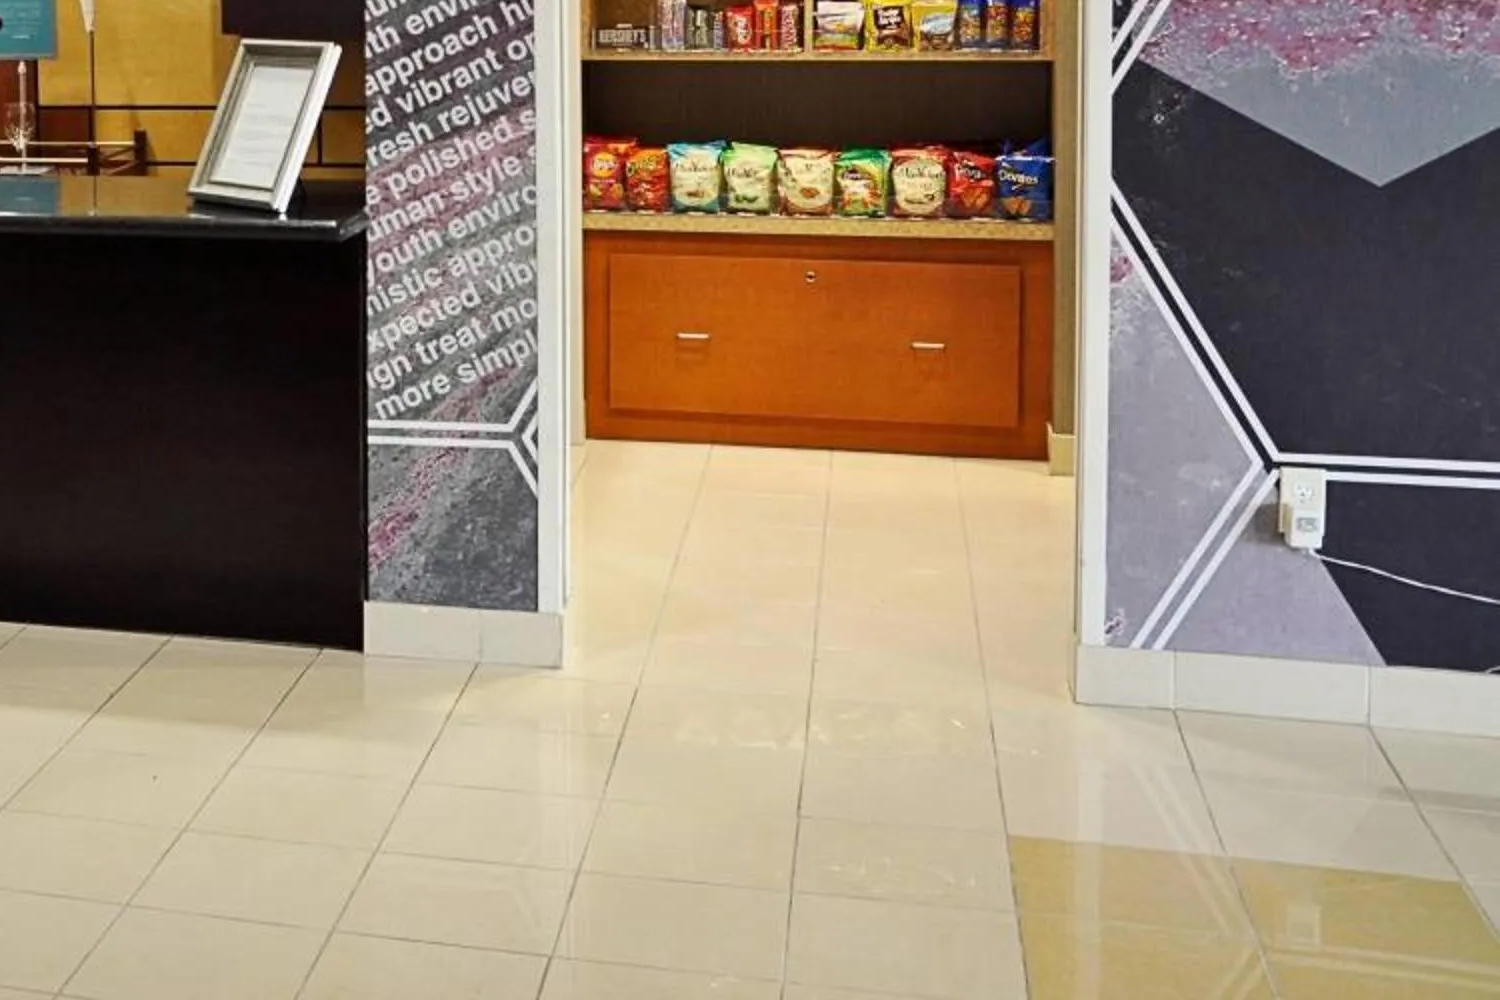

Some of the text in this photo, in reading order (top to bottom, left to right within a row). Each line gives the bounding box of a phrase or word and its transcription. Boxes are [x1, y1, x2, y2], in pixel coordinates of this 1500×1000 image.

[365, 13, 498, 97] approach
[397, 47, 502, 115] vibrant
[387, 114, 514, 200] polished
[452, 151, 522, 203] style
[415, 315, 488, 366] treat
[375, 372, 451, 420] more
